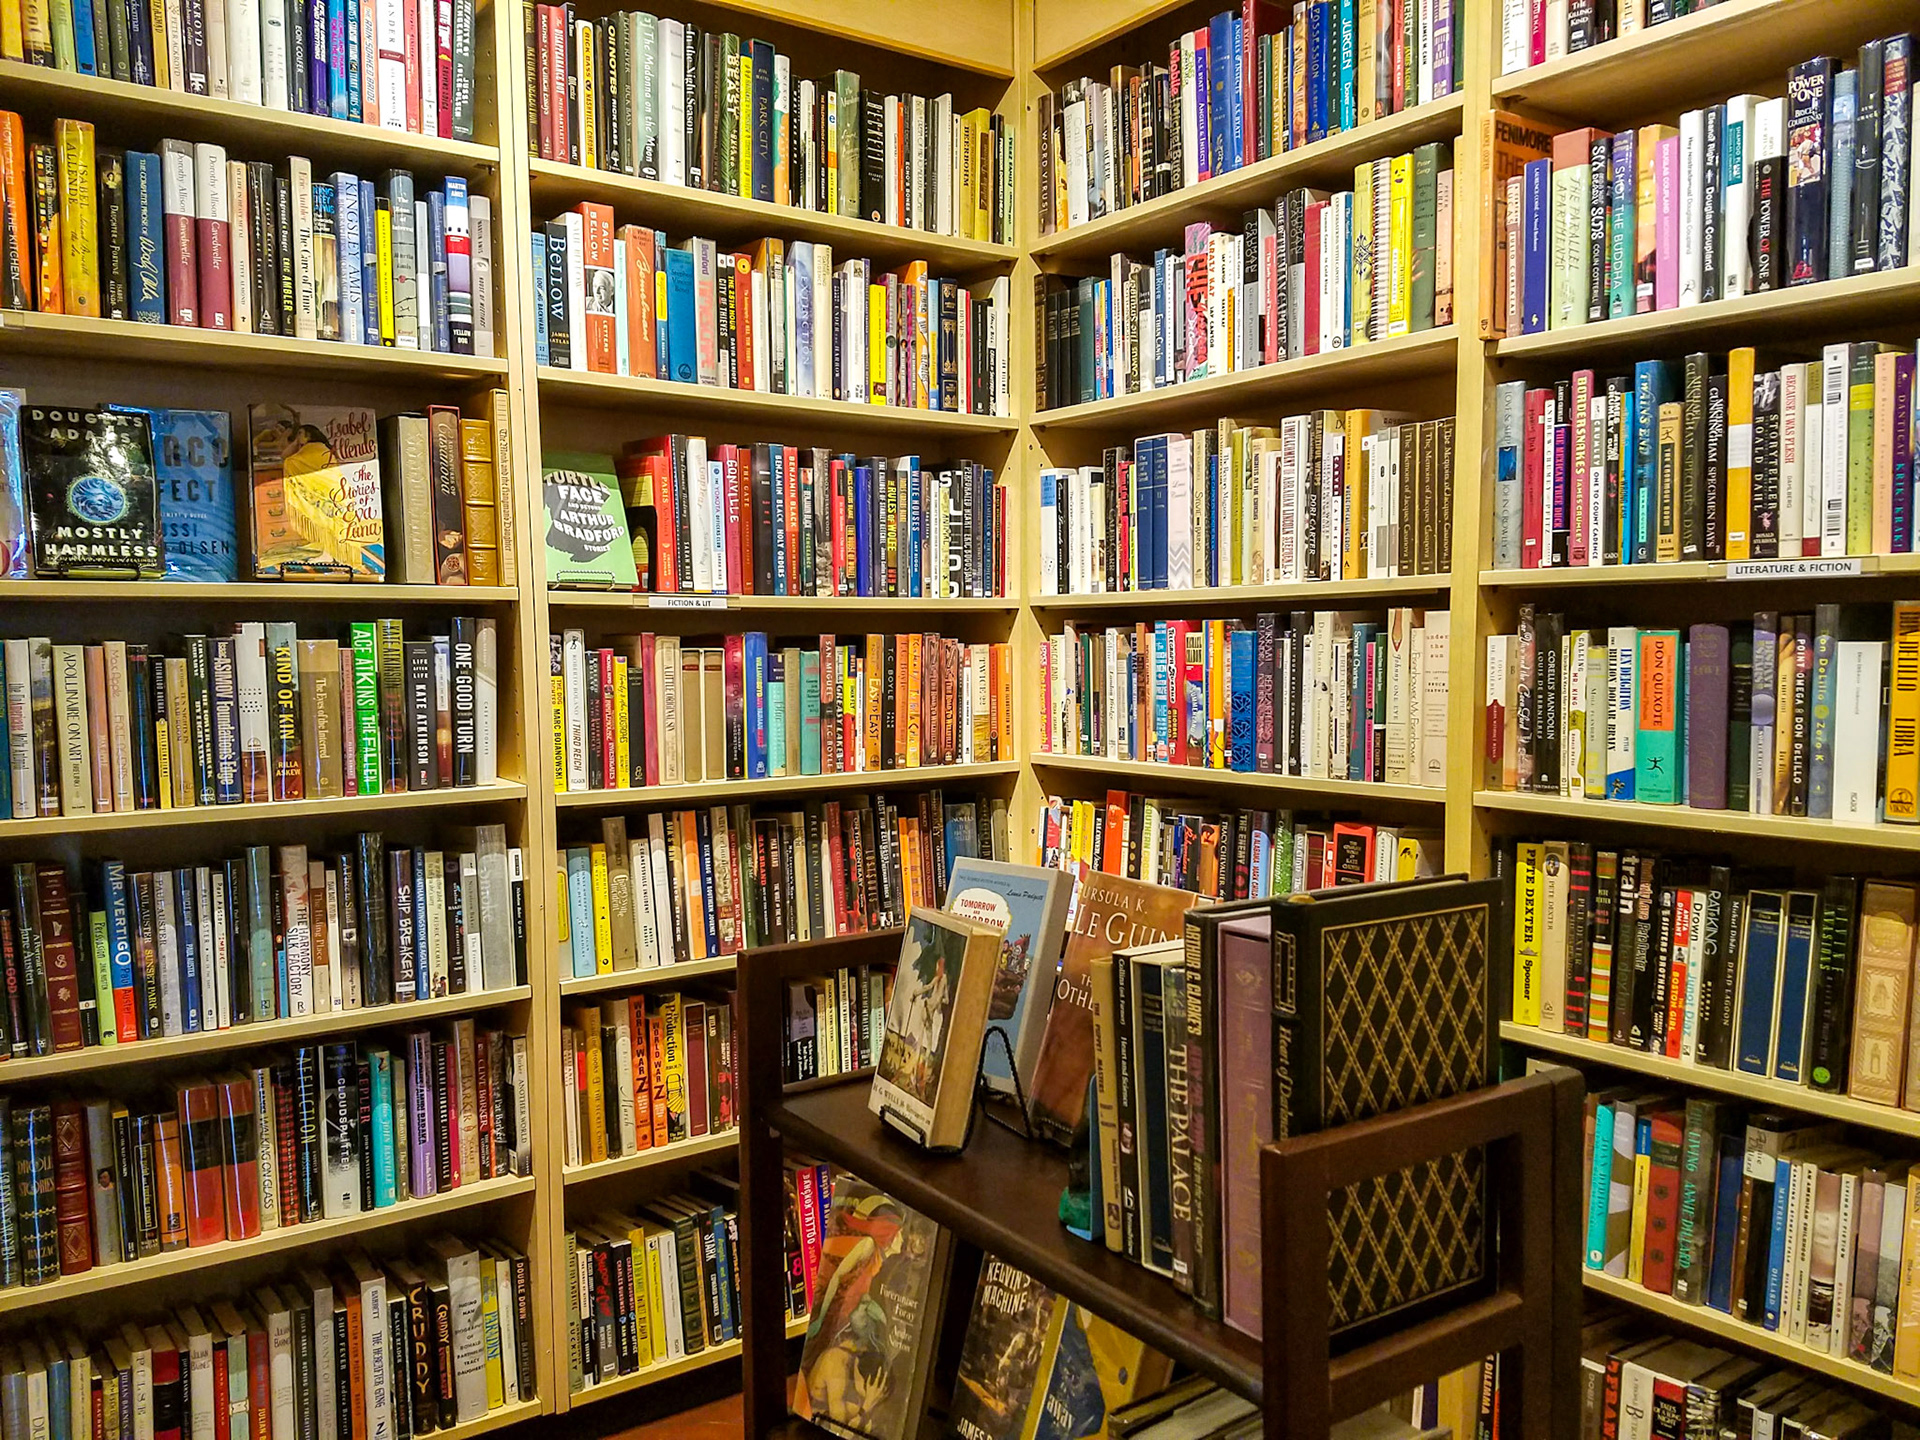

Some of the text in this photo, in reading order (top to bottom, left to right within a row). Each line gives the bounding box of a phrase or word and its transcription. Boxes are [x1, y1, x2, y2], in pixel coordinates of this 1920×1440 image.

[1342, 18, 1352, 69] JURGEN
[727, 54, 738, 117] BEAST
[1170, 50, 1180, 97] Mobile
[759, 97, 768, 160] PARK CITY
[1172, 150, 1182, 188] Butor
[1614, 166, 1625, 200] SHOT
[1761, 177, 1771, 198] THE
[176, 152, 190, 265] Dorothy Allison Cavedweller
[208, 155, 221, 270] Dorothy Allison Cavedweller
[1614, 204, 1625, 229] THE
[1704, 187, 1714, 224] Douglas
[1760, 200, 1771, 238] POWER
[8, 197, 19, 281] IN THE KITCHEN
[346, 182, 361, 303] KINGSLEY AMIS
[590, 211, 599, 260] BELLOW
[601, 221, 609, 252] SAUL
[1704, 226, 1713, 271] Coupland
[300, 227, 313, 314] The Care of Time
[1613, 234, 1624, 289] BUDDHA
[1759, 254, 1770, 278] ONE
[282, 257, 293, 311] ERIC AMBLER
[1767, 414, 1779, 509] STORYTELLER
[557, 485, 605, 504] FACE
[57, 526, 143, 540] MOSTLY
[553, 519, 625, 542] BRADFORD
[560, 510, 615, 526] ARTHUR
[45, 543, 158, 557] HARMLESS
[777, 551, 785, 578] ORDERS
[1735, 566, 1795, 575] LITERATURE
[1808, 563, 1852, 571] FICTION
[1797, 639, 1806, 668] POINT
[213, 657, 230, 698] ASIMOV
[276, 647, 295, 739] KIND OF KIN
[1653, 641, 1665, 726] DON QUIXOTE
[1796, 672, 1805, 705] OMEGA
[353, 629, 378, 782] ACE ATKINS THE FALLEN
[455, 643, 473, 753] ONE GOOD TURN
[68, 723, 81, 741] ON
[415, 684, 428, 764] KATE ATKINSON
[553, 708, 561, 730] MARC
[1794, 717, 1804, 738] DON
[1893, 718, 1916, 757] LIBRA
[69, 742, 82, 763] ART
[218, 761, 236, 785] Edge
[1082, 885, 1130, 909] URSULA
[1619, 856, 1640, 914] train
[113, 898, 132, 965] VERTIGO
[297, 907, 310, 976] THE HARMONY
[398, 885, 414, 978] SHIP BREAKER
[1522, 849, 1536, 1000] PETE DEXTER Spooner
[1691, 903, 1703, 942] Drown
[19, 927, 35, 985] Jane Austen
[287, 928, 301, 996] SILK FACTORY
[419, 942, 428, 970] SEAGULL
[148, 986, 158, 1010] PARK
[1169, 1044, 1188, 1104] THE
[704, 1233, 717, 1262] STARK
